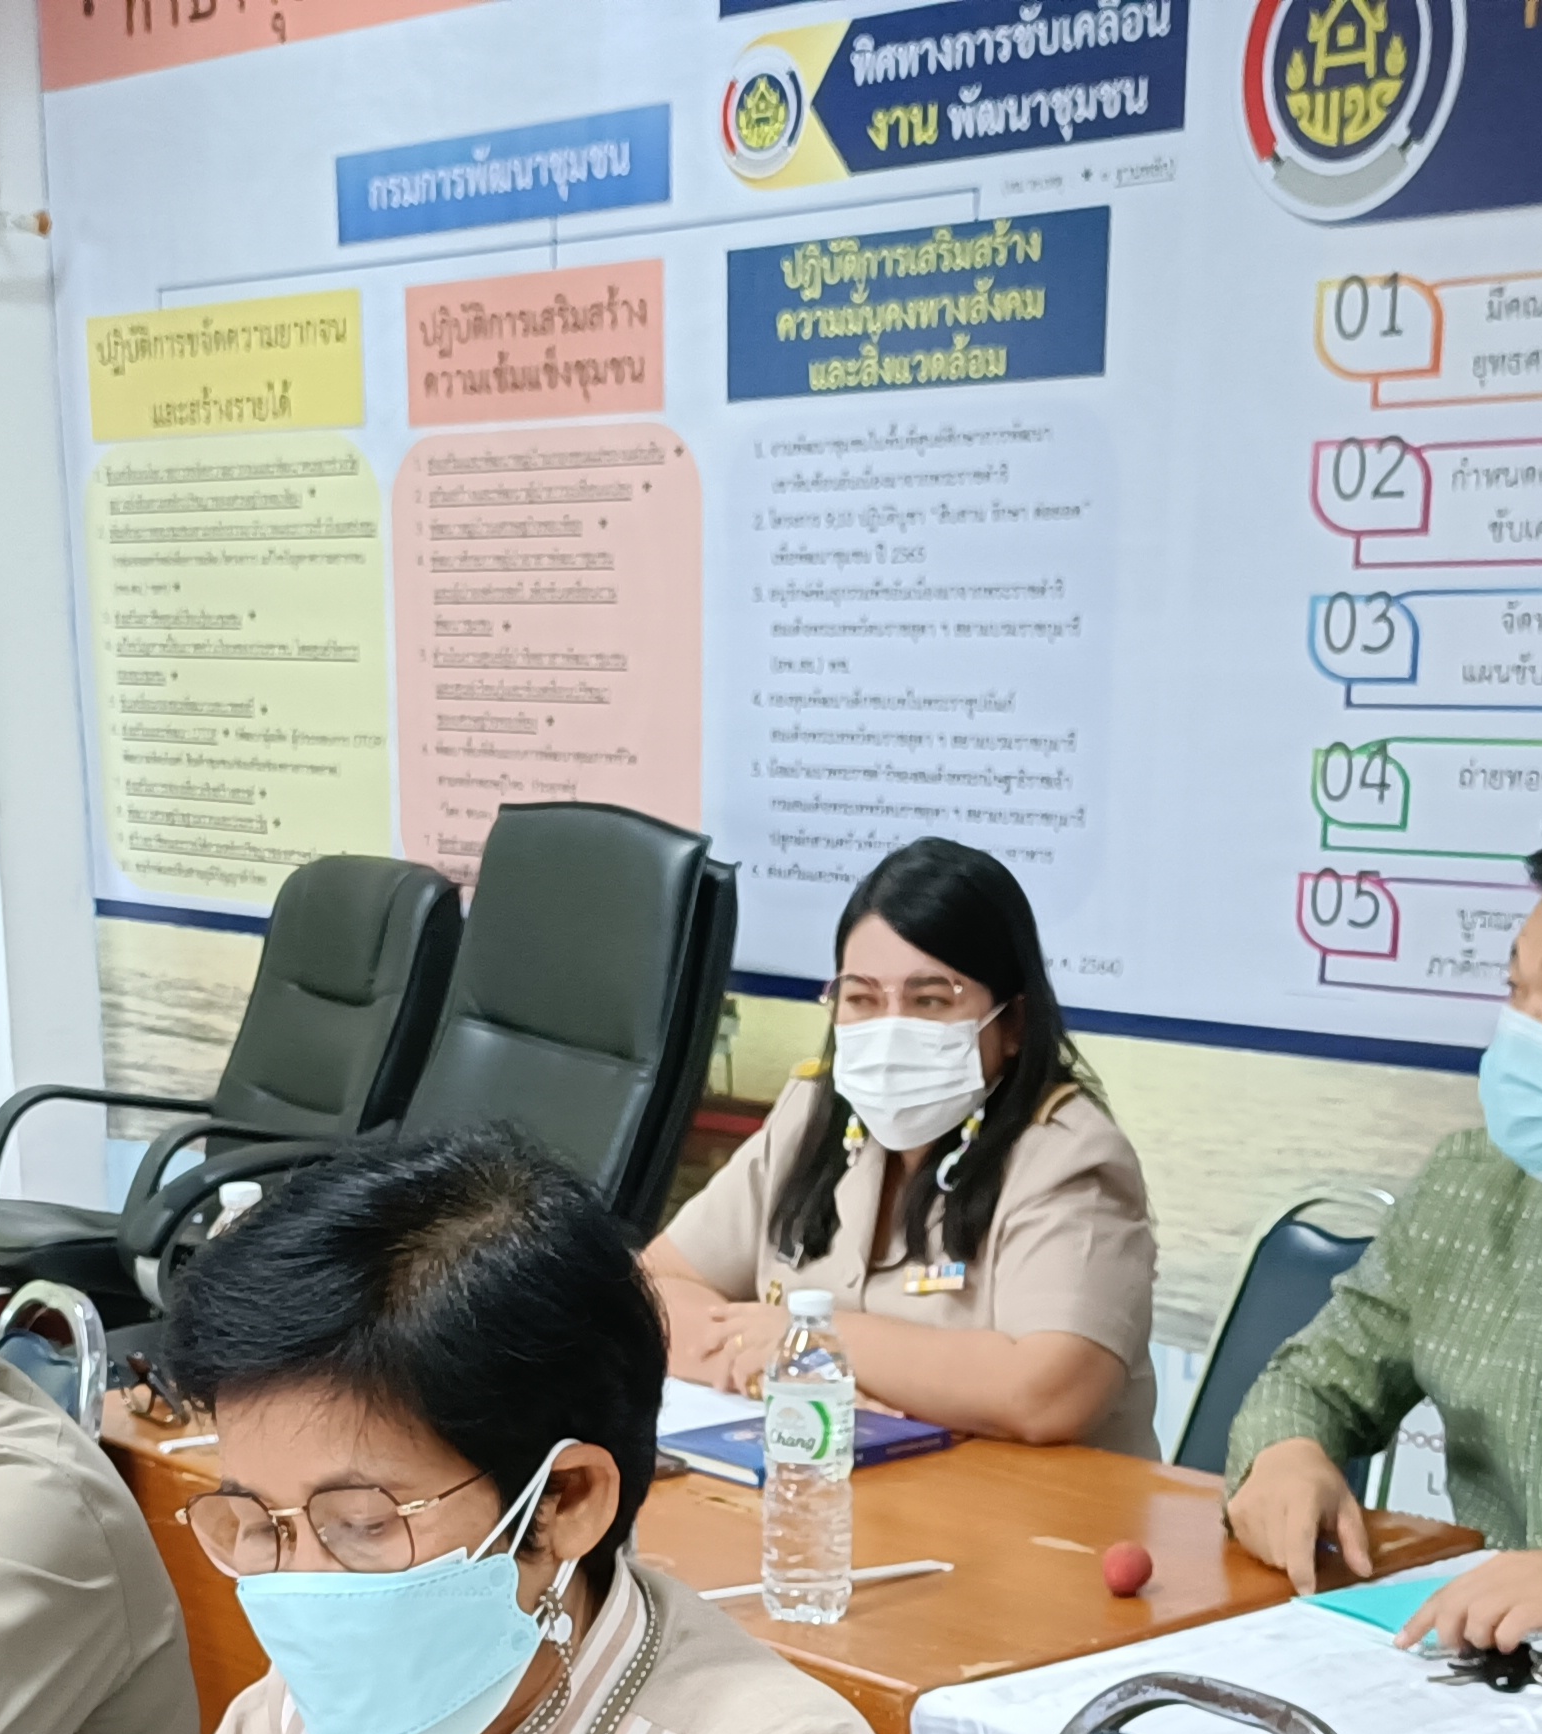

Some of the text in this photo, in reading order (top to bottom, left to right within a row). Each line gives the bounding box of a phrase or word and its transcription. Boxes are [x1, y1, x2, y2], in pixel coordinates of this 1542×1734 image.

[867, 76, 1149, 151] งาน พัฒนาชุมชน
[367, 140, 630, 211] กรมการพัฒนาชุมชน
[1333, 272, 1405, 340] 01
[1331, 435, 1407, 502] 02
[1324, 590, 1395, 655] 03
[1320, 741, 1390, 804] 04
[1311, 868, 1379, 928] 05
